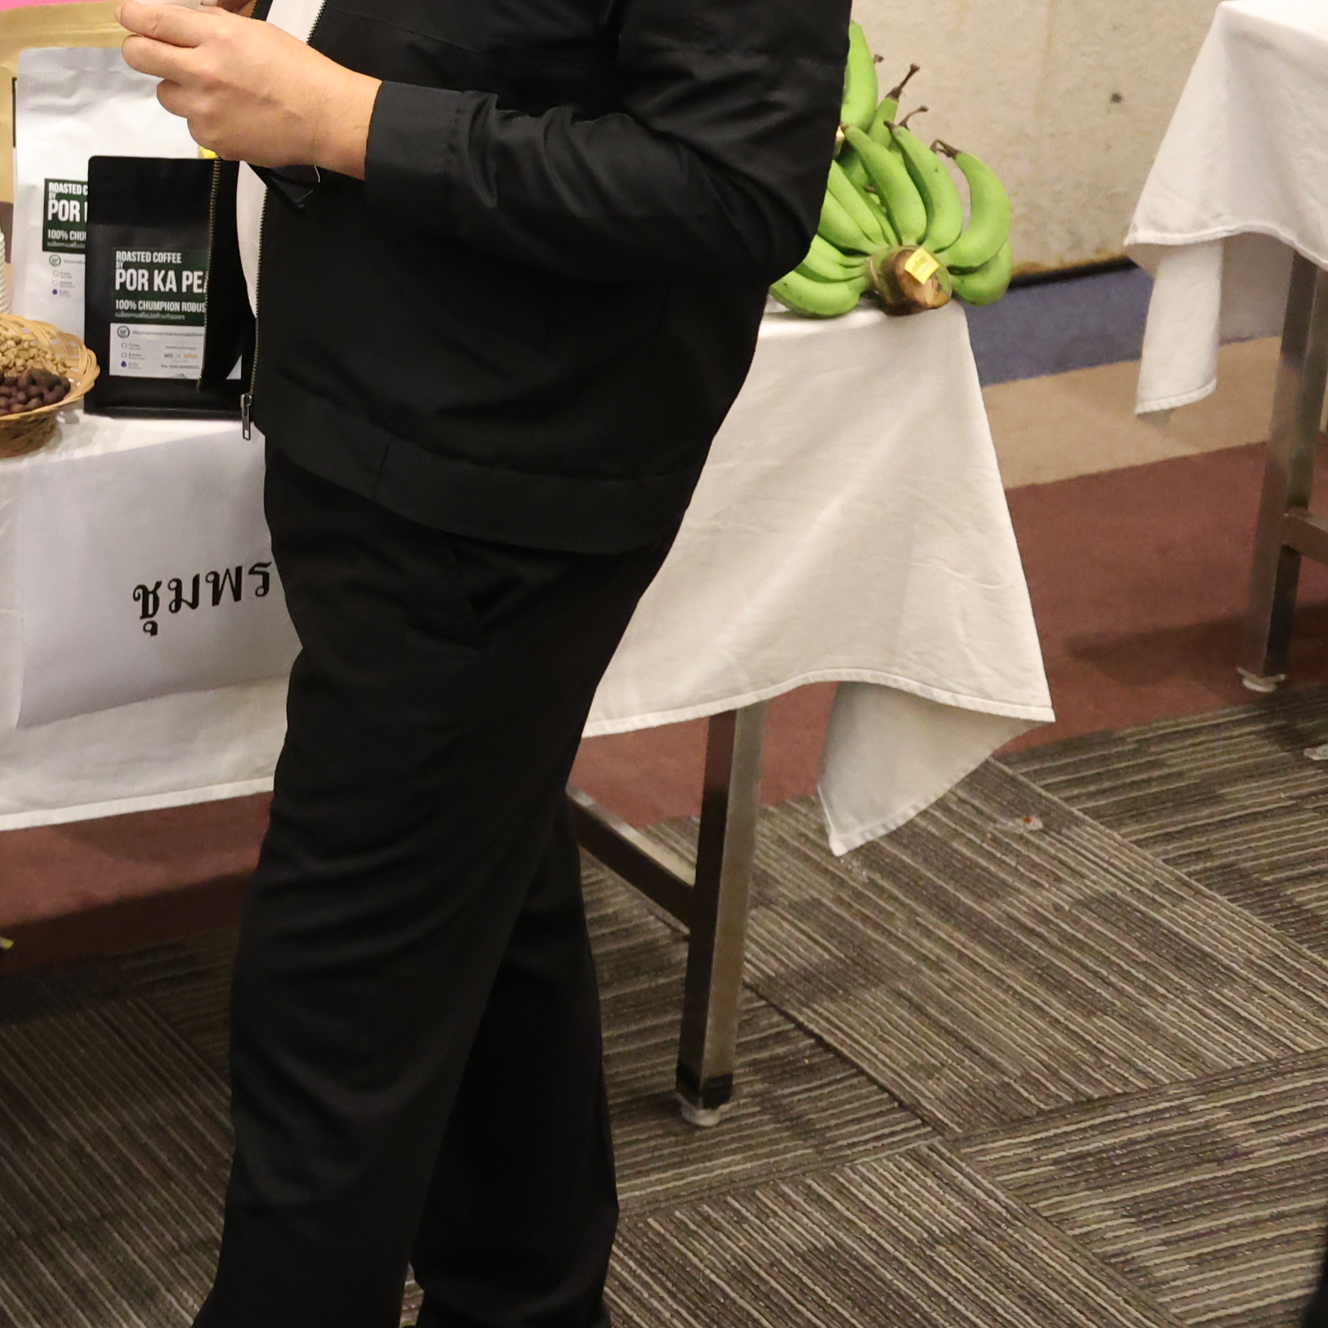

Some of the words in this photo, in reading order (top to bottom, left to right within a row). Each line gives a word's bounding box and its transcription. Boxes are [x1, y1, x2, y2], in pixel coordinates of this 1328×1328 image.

[48, 182, 82, 195] ROASTED
[47, 199, 81, 222] POR
[47, 229, 69, 240] 100%
[116, 251, 151, 263] ROASTED
[152, 252, 182, 264] COFFEE
[116, 261, 124, 269] BY
[115, 268, 149, 291] POR
[153, 269, 177, 292] KA
[181, 270, 206, 293] PE
[115, 299, 137, 310] 100%
[138, 300, 180, 312] CHUMPHON
[132, 560, 272, 636] ชุมพร
